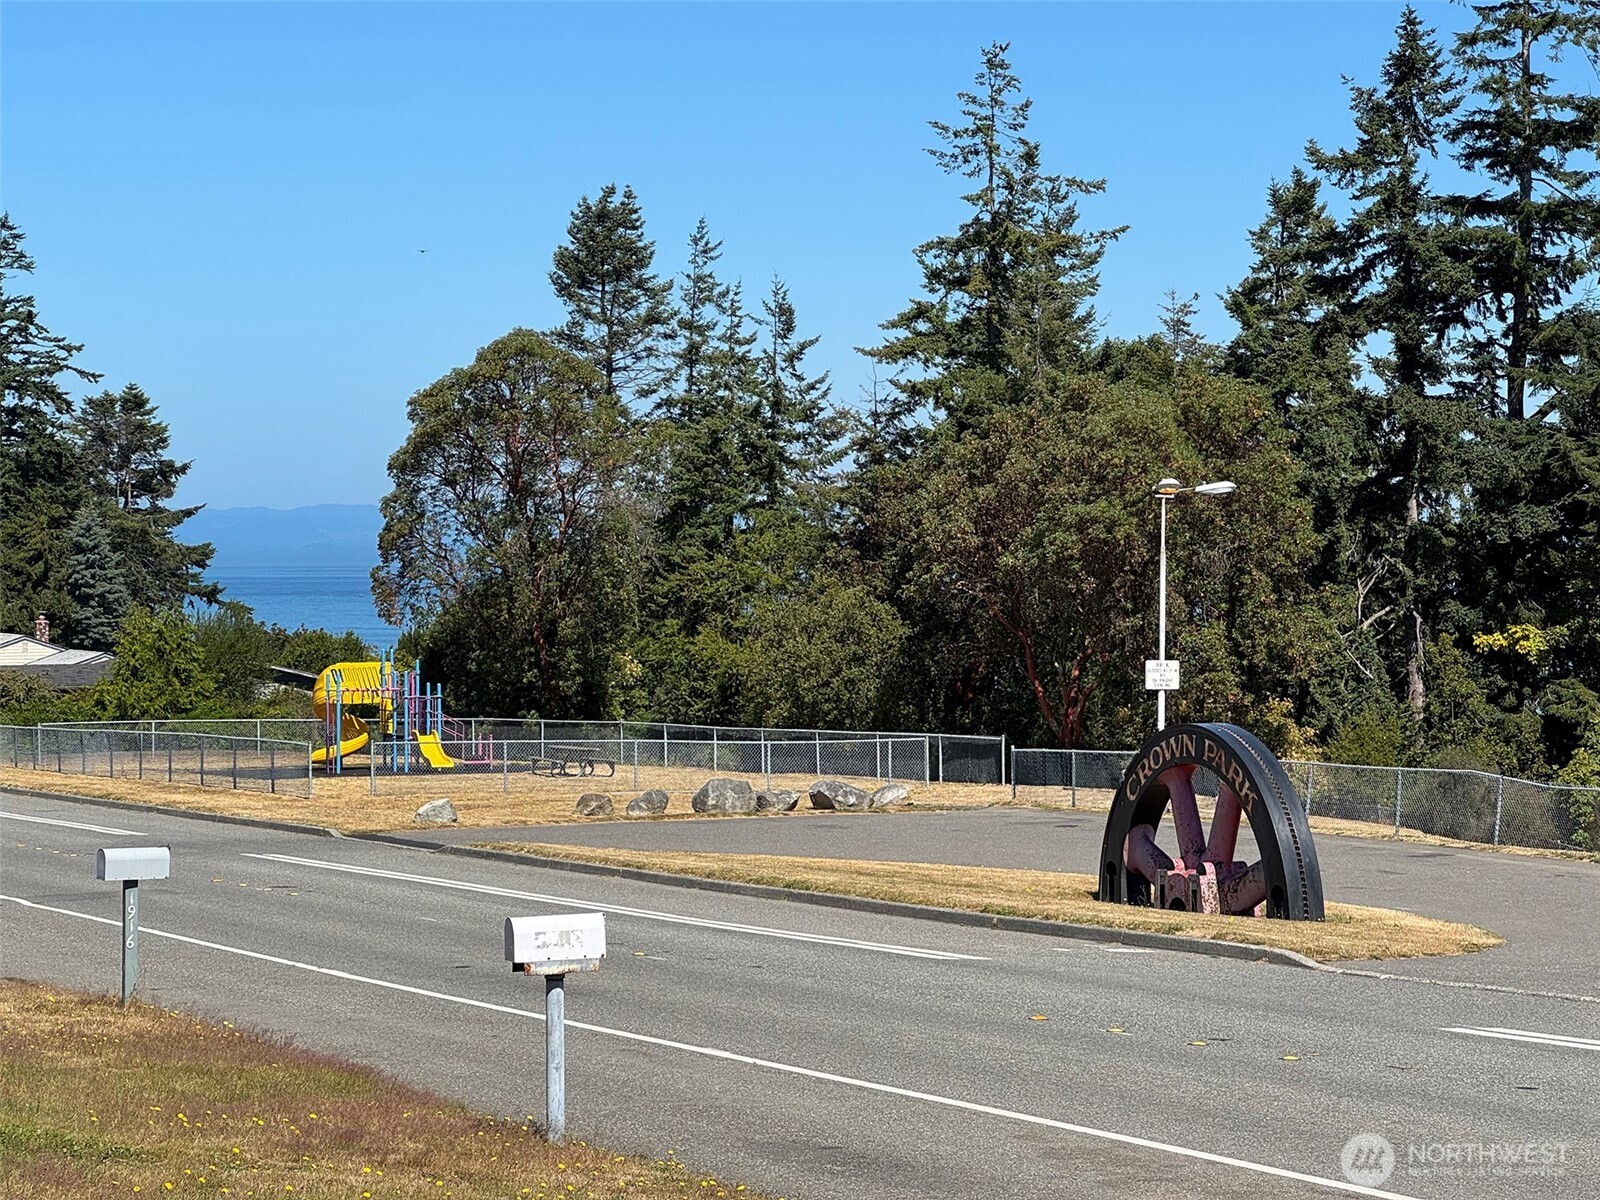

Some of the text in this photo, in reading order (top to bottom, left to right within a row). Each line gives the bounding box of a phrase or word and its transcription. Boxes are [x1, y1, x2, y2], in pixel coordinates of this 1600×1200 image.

[1126, 734, 1259, 815] CROWN PARK
[126, 891, 136, 949] 1916
